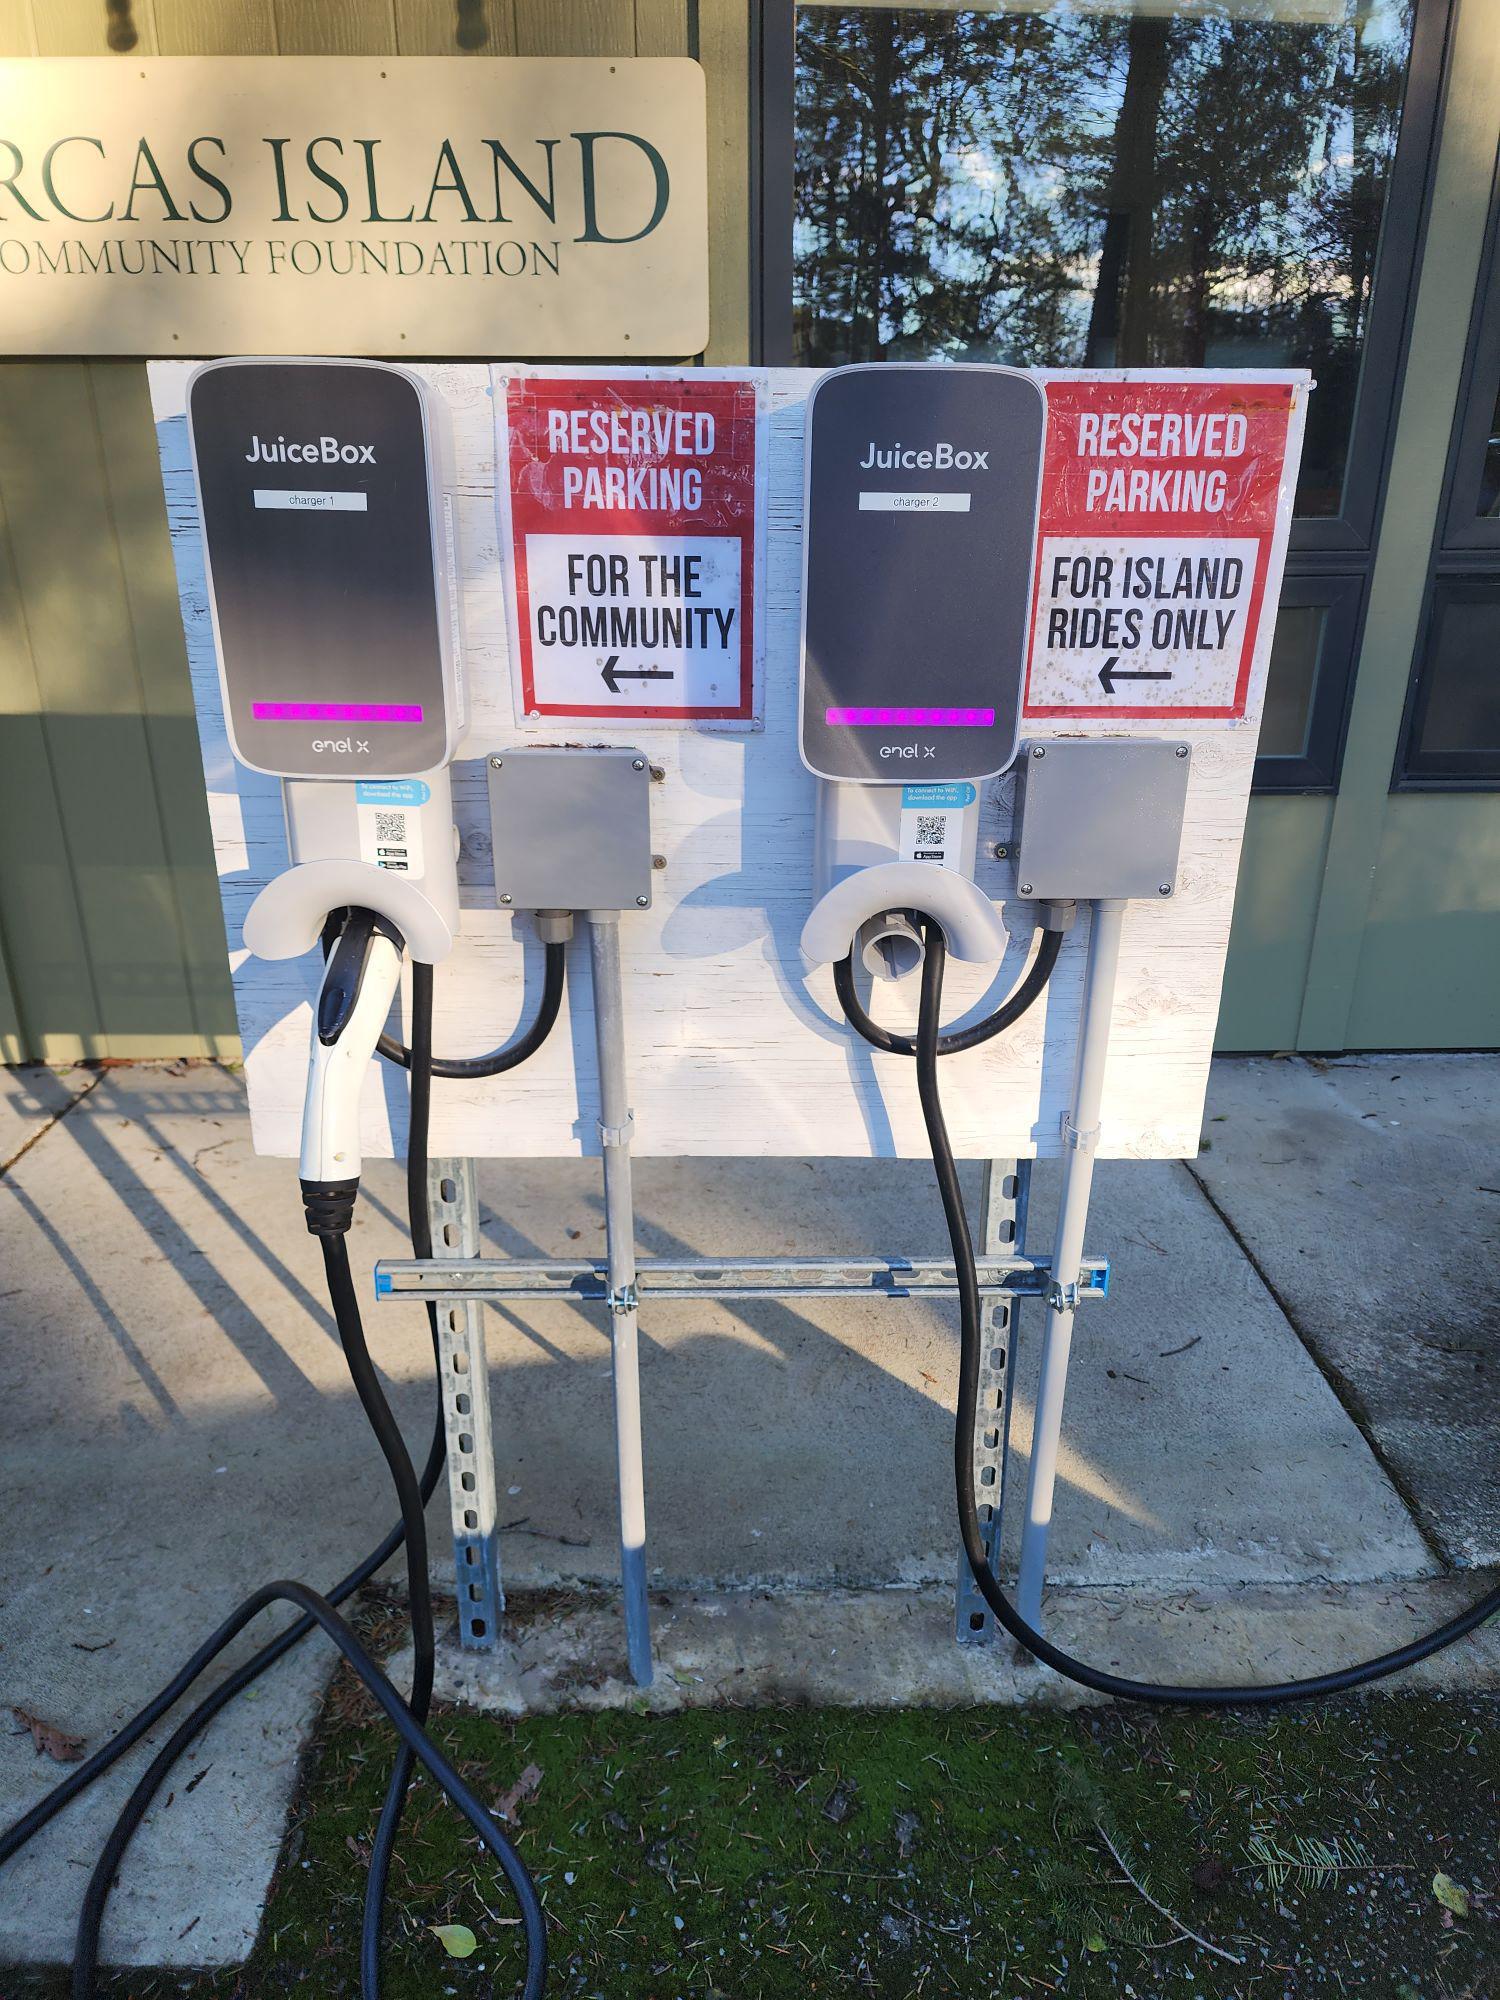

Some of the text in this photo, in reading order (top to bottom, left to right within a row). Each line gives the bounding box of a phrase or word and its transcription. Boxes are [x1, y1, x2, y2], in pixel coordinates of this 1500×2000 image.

[262, 131, 670, 244] ISLAND
[0, 239, 562, 277] OMMUNITY FOUNDATION
[245, 435, 377, 464] JuiceBox
[548, 408, 716, 456] RESERVED
[1077, 412, 1248, 458] RESERVED
[859, 442, 990, 470] JuiceBox
[289, 494, 334, 506] charger 1
[563, 466, 703, 511] PARKING
[893, 496, 939, 508] charger 2
[1085, 468, 1228, 513] PARKING
[567, 553, 702, 598] FOR THE
[1050, 556, 1244, 600] FOR ISLAND
[537, 604, 736, 650] COMMUNITY
[1047, 607, 1237, 651] RIDES ONLY
[311, 737, 353, 753] enel
[879, 743, 919, 759] enel
